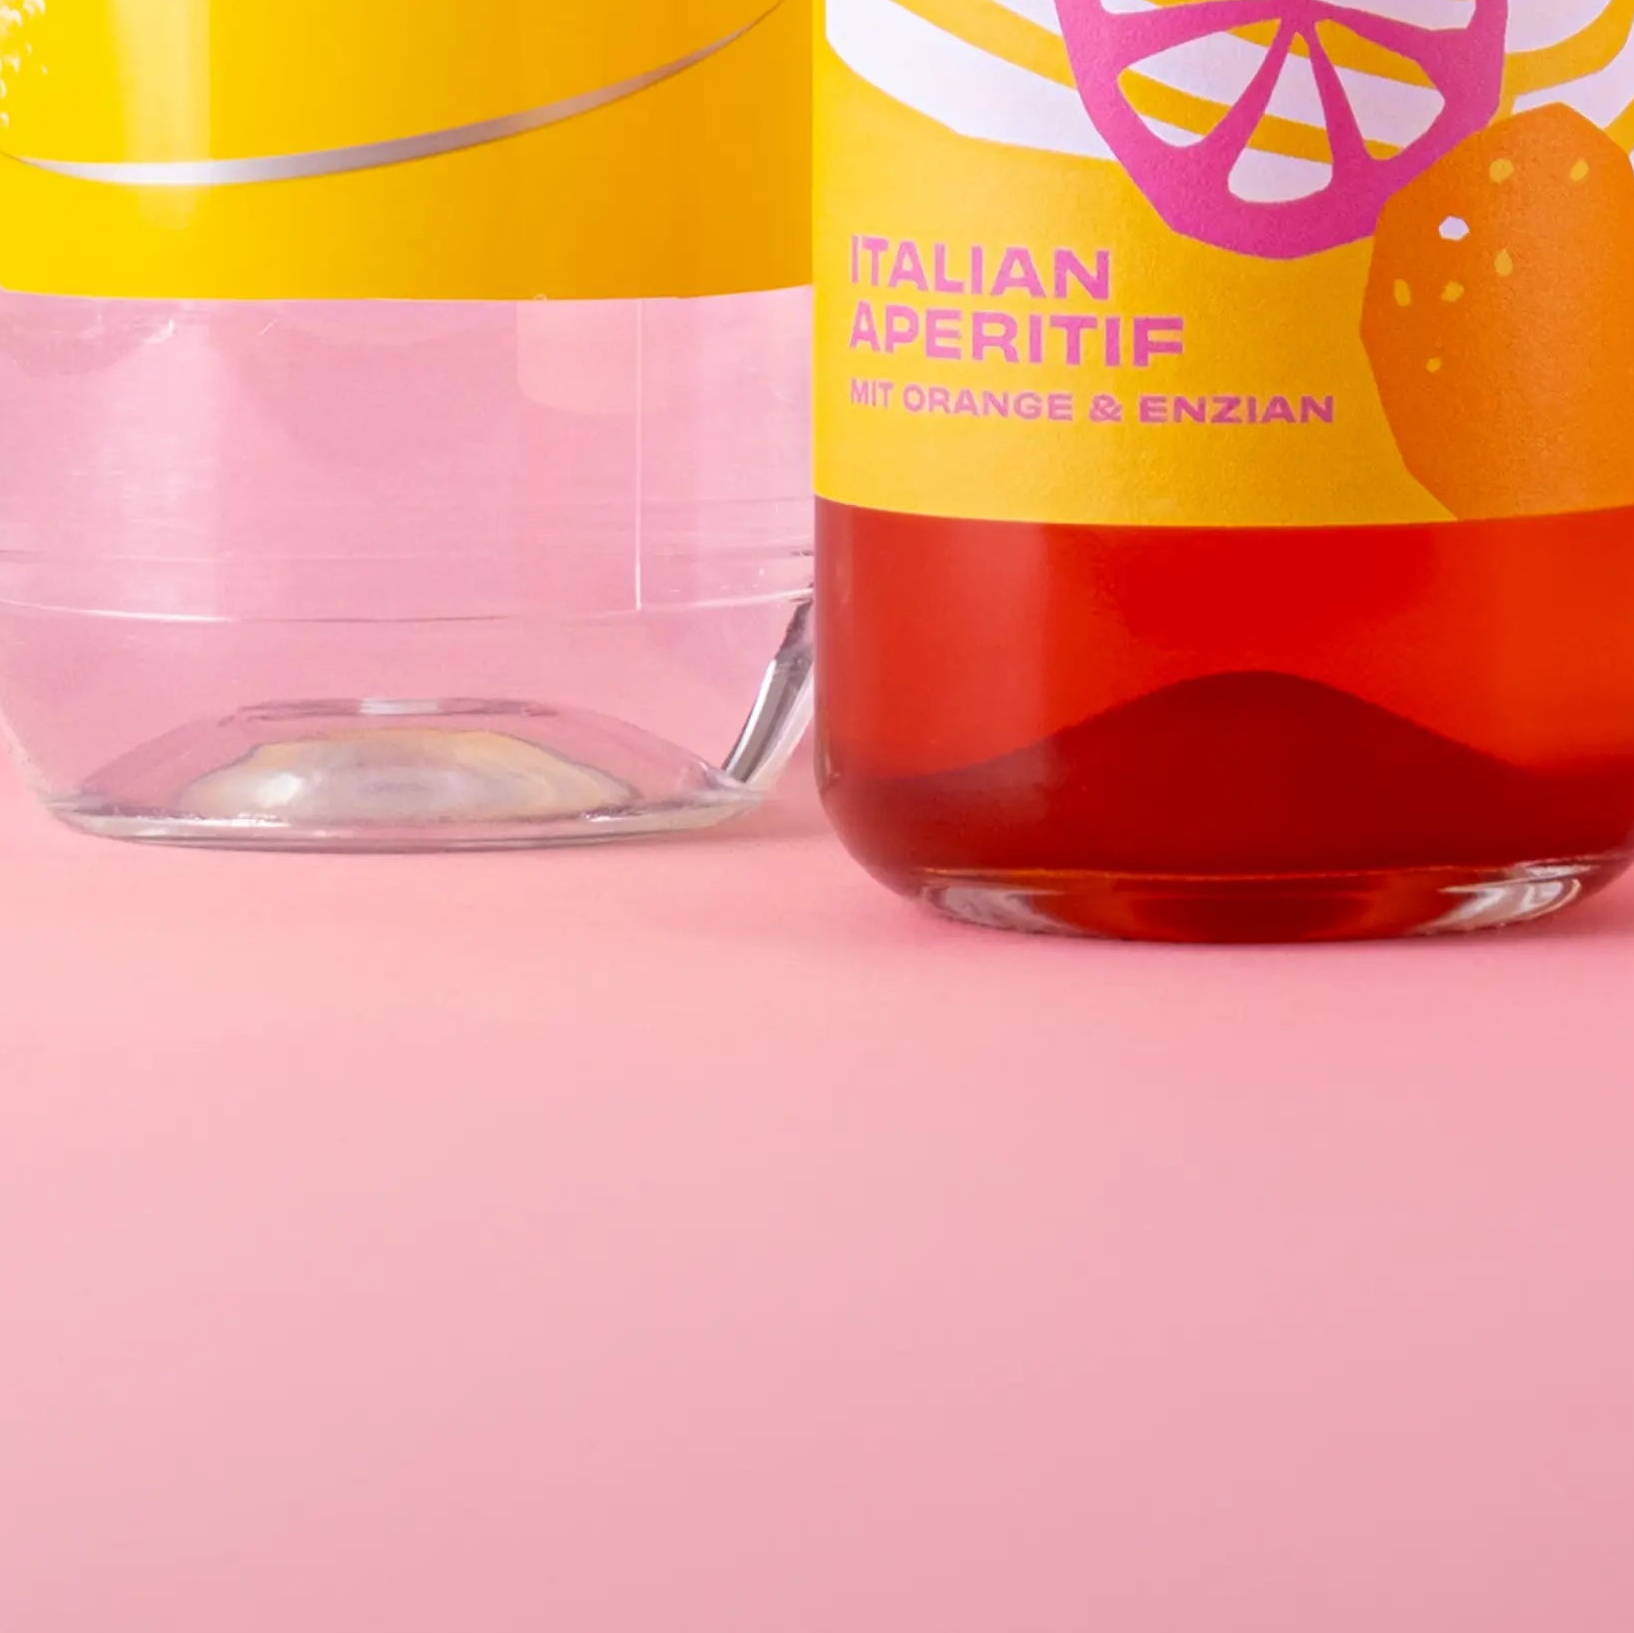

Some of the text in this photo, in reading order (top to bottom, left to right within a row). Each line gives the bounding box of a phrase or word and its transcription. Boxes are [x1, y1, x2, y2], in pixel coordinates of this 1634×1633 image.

[850, 234, 1111, 300] ITALIAN
[849, 300, 1185, 368] APERITIF
[850, 378, 1334, 424] MIT ORANGE & ENZIAN
